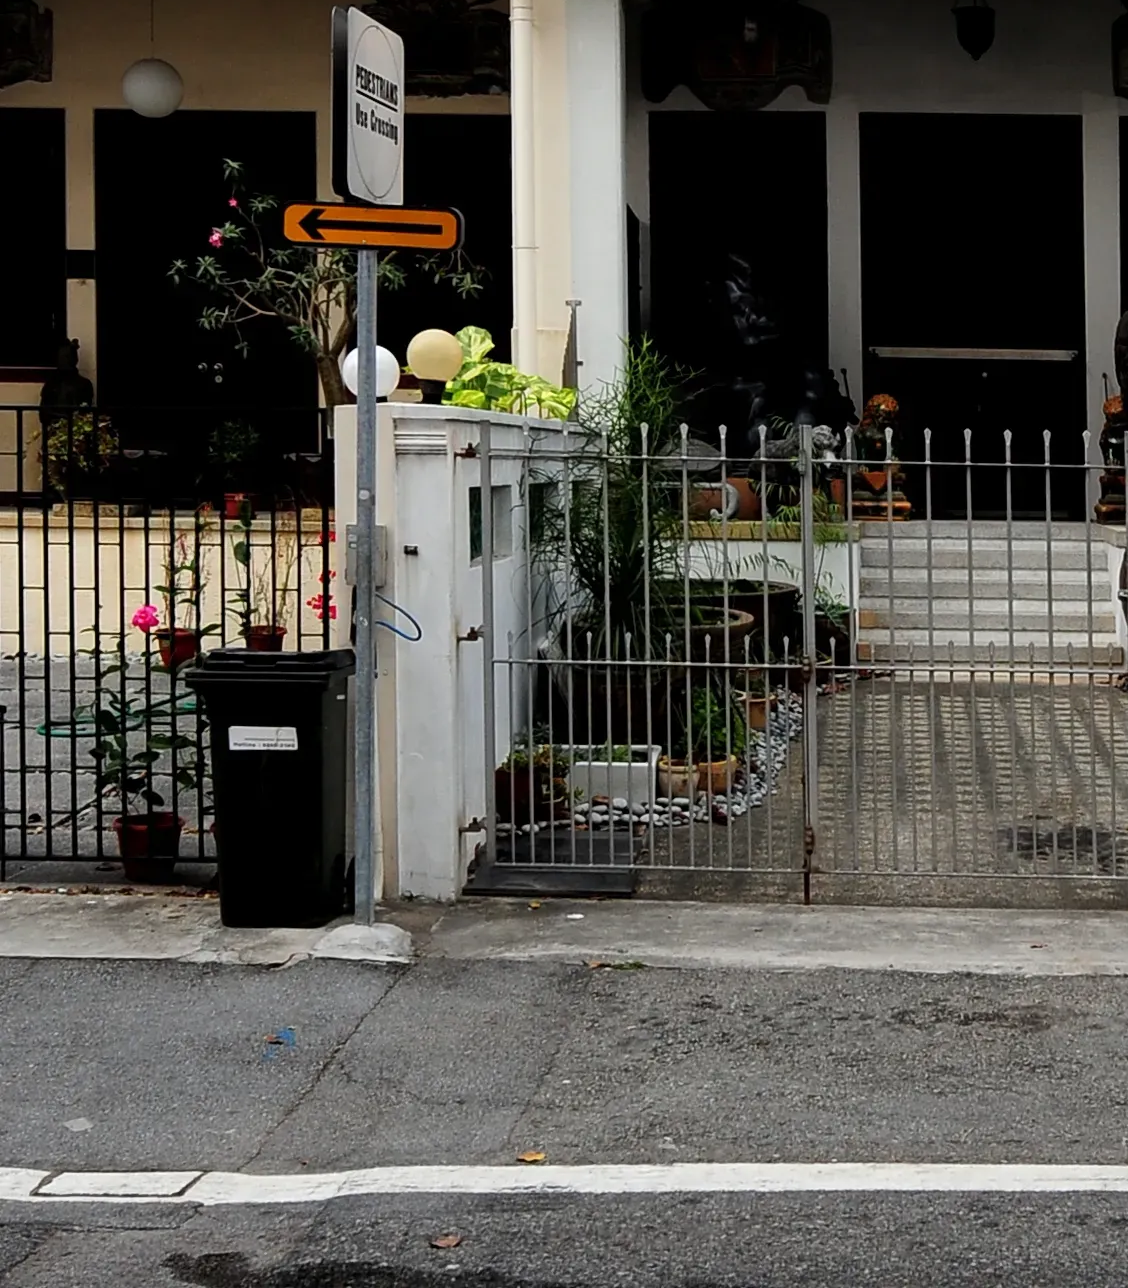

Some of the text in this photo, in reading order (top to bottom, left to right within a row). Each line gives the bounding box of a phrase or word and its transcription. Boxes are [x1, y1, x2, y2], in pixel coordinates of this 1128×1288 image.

[356, 64, 398, 106] PEDESTRIANS
[356, 102, 398, 145] Use Crossing
